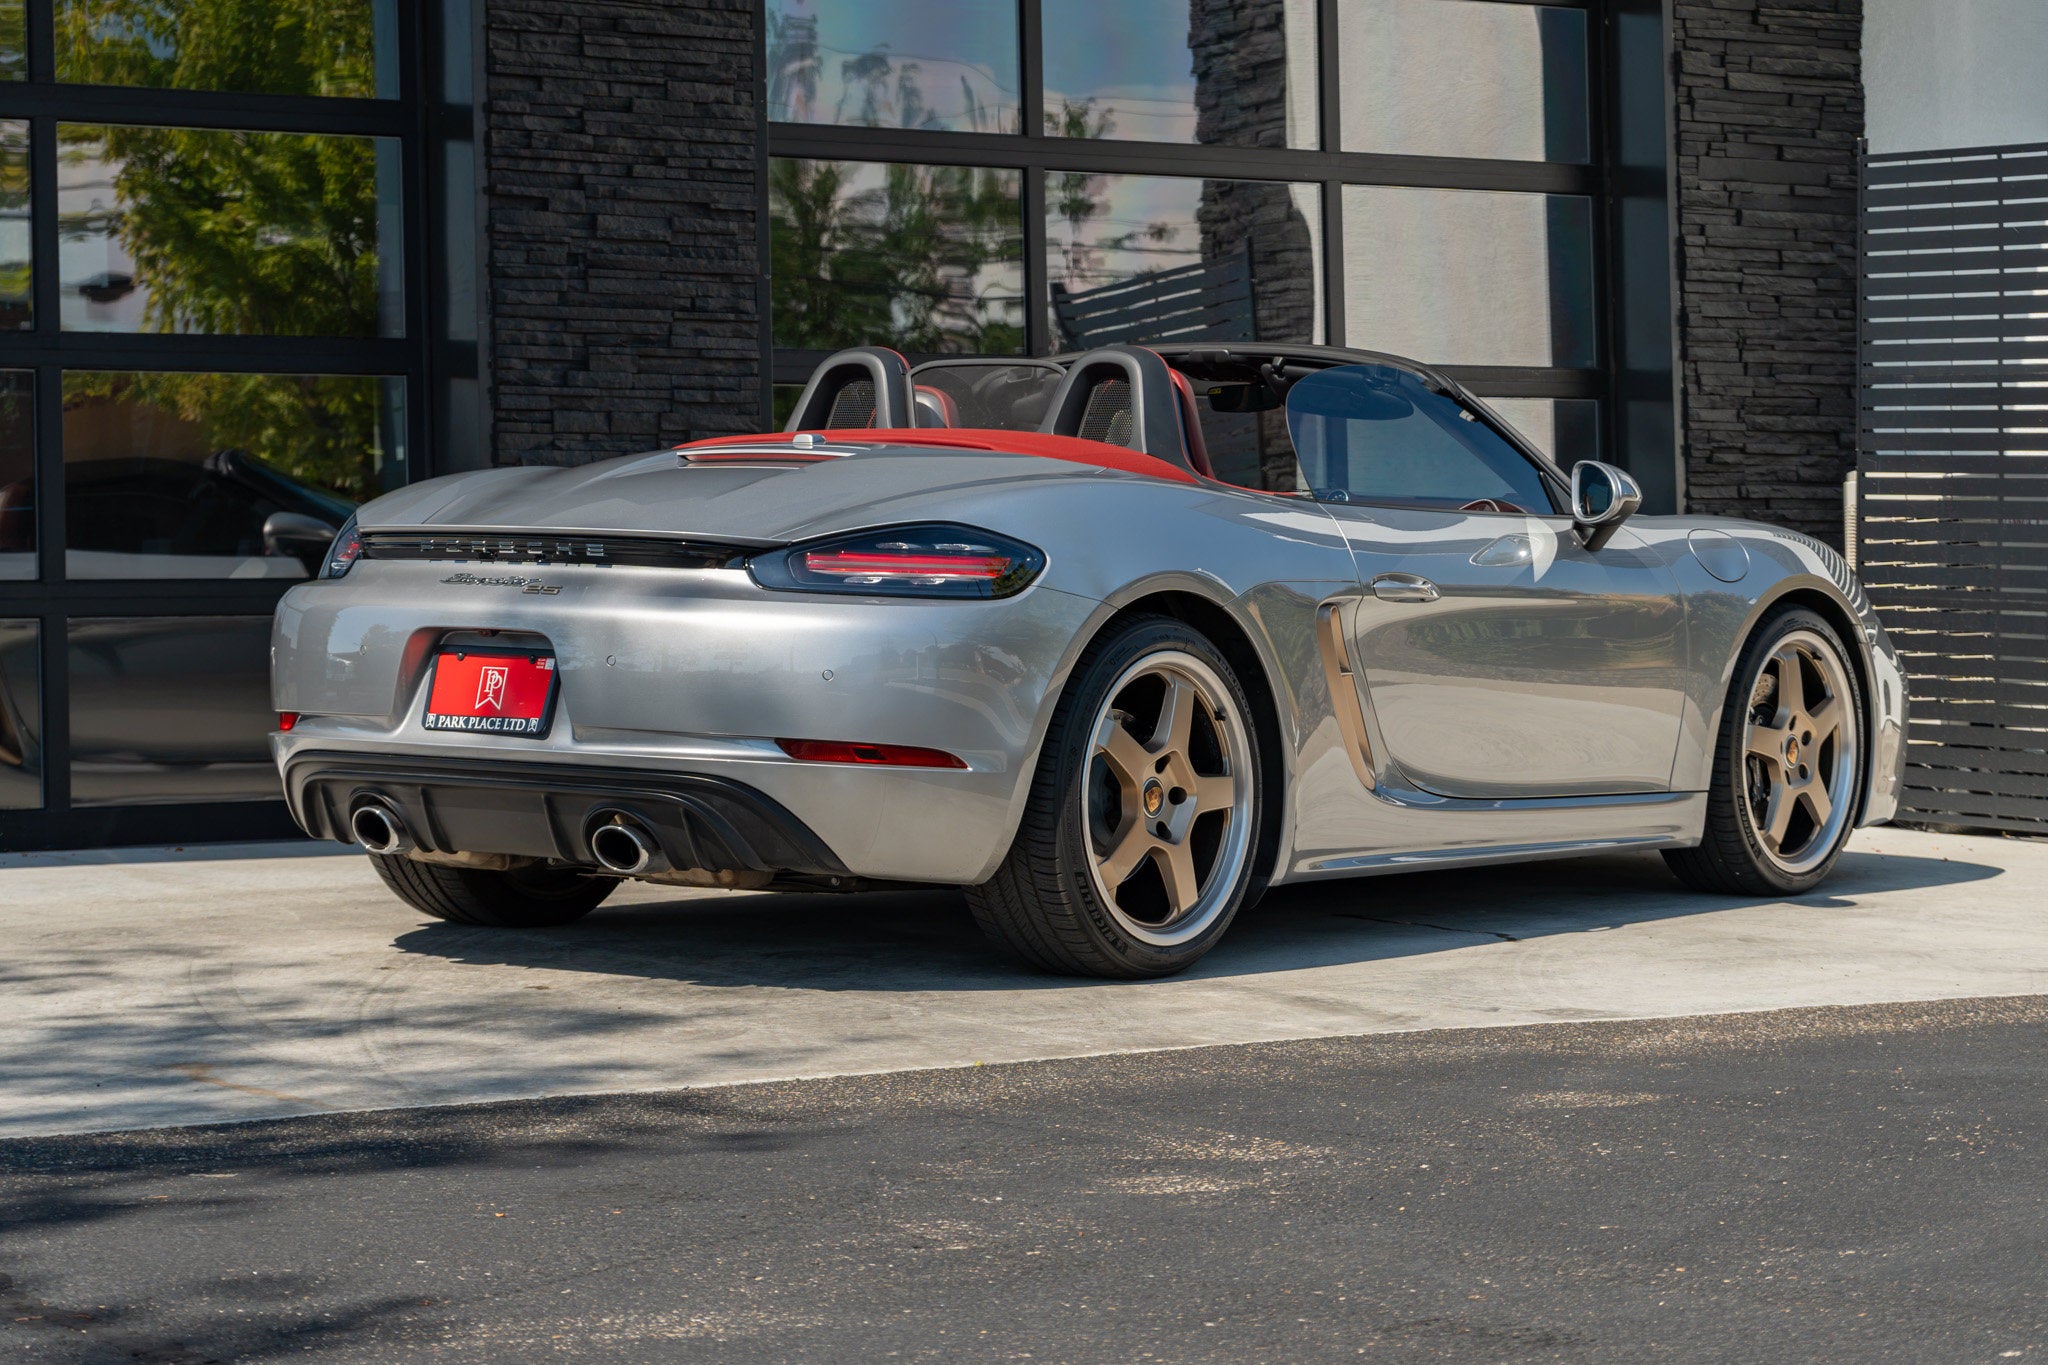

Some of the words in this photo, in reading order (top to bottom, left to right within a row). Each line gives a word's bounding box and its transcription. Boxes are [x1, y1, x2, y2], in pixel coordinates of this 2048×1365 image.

[420, 540, 604, 557] PORSCHE
[522, 585, 562, 595] 25
[437, 715, 468, 729] PARK
[467, 717, 501, 730] PLACE
[502, 718, 527, 731] LTD
[1077, 875, 1117, 942] MICHELIN
